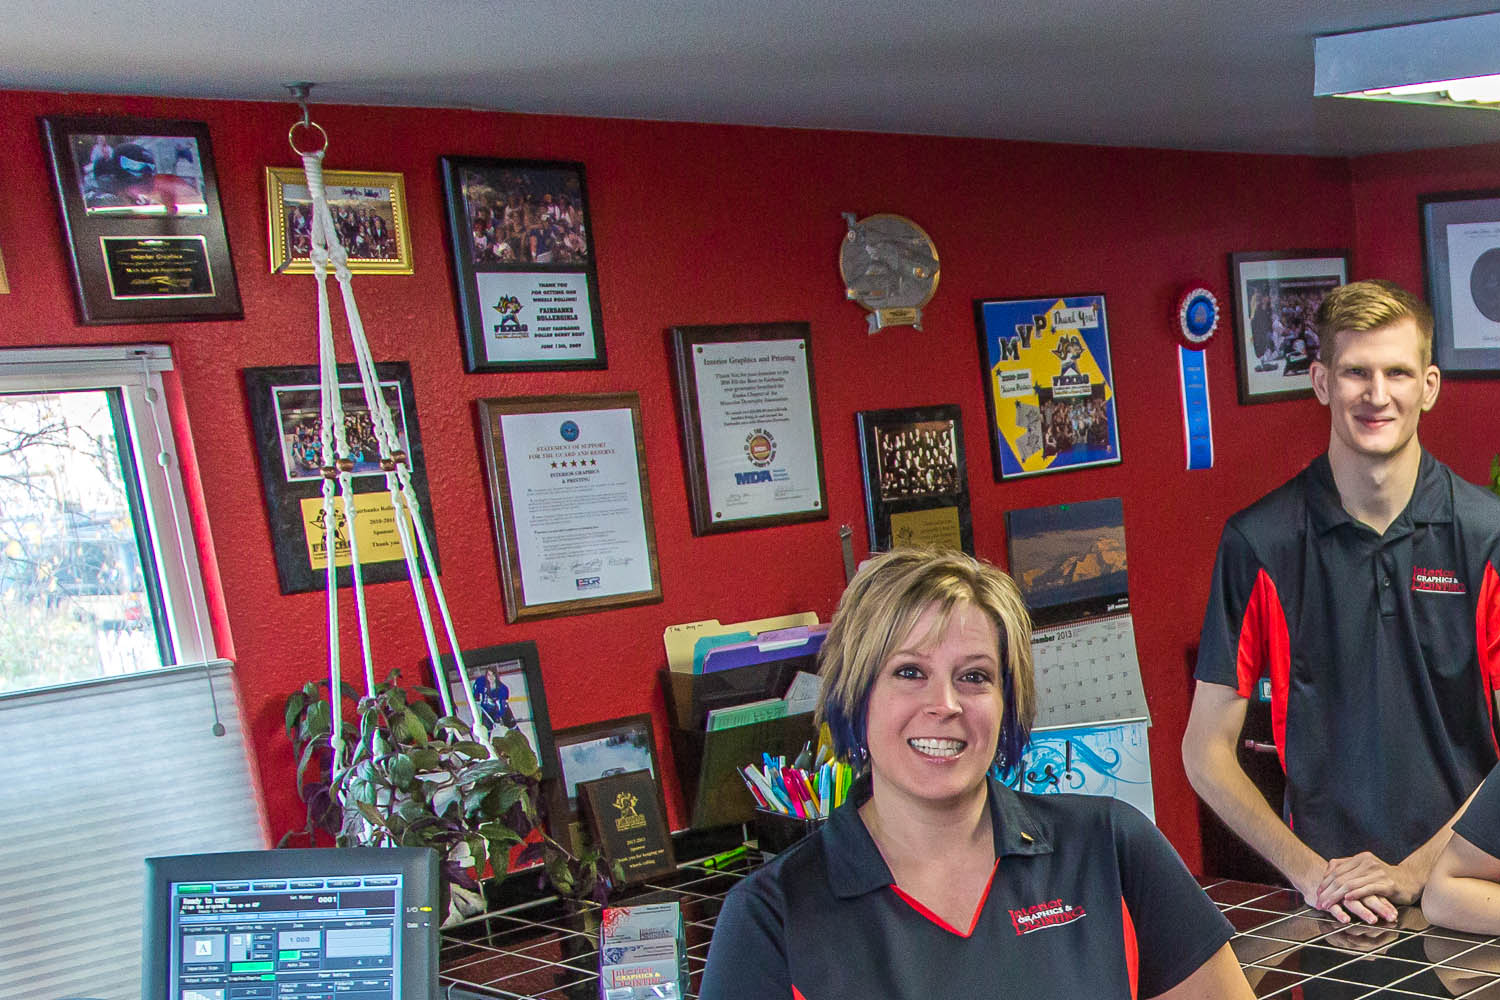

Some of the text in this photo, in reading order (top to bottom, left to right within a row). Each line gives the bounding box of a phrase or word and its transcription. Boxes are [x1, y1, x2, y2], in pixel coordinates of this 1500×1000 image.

[729, 358, 757, 366] Graphics
[734, 470, 773, 486] MDA
[1056, 630, 1072, 640] 2013
[1018, 904, 1072, 924] GRAPHICS &
